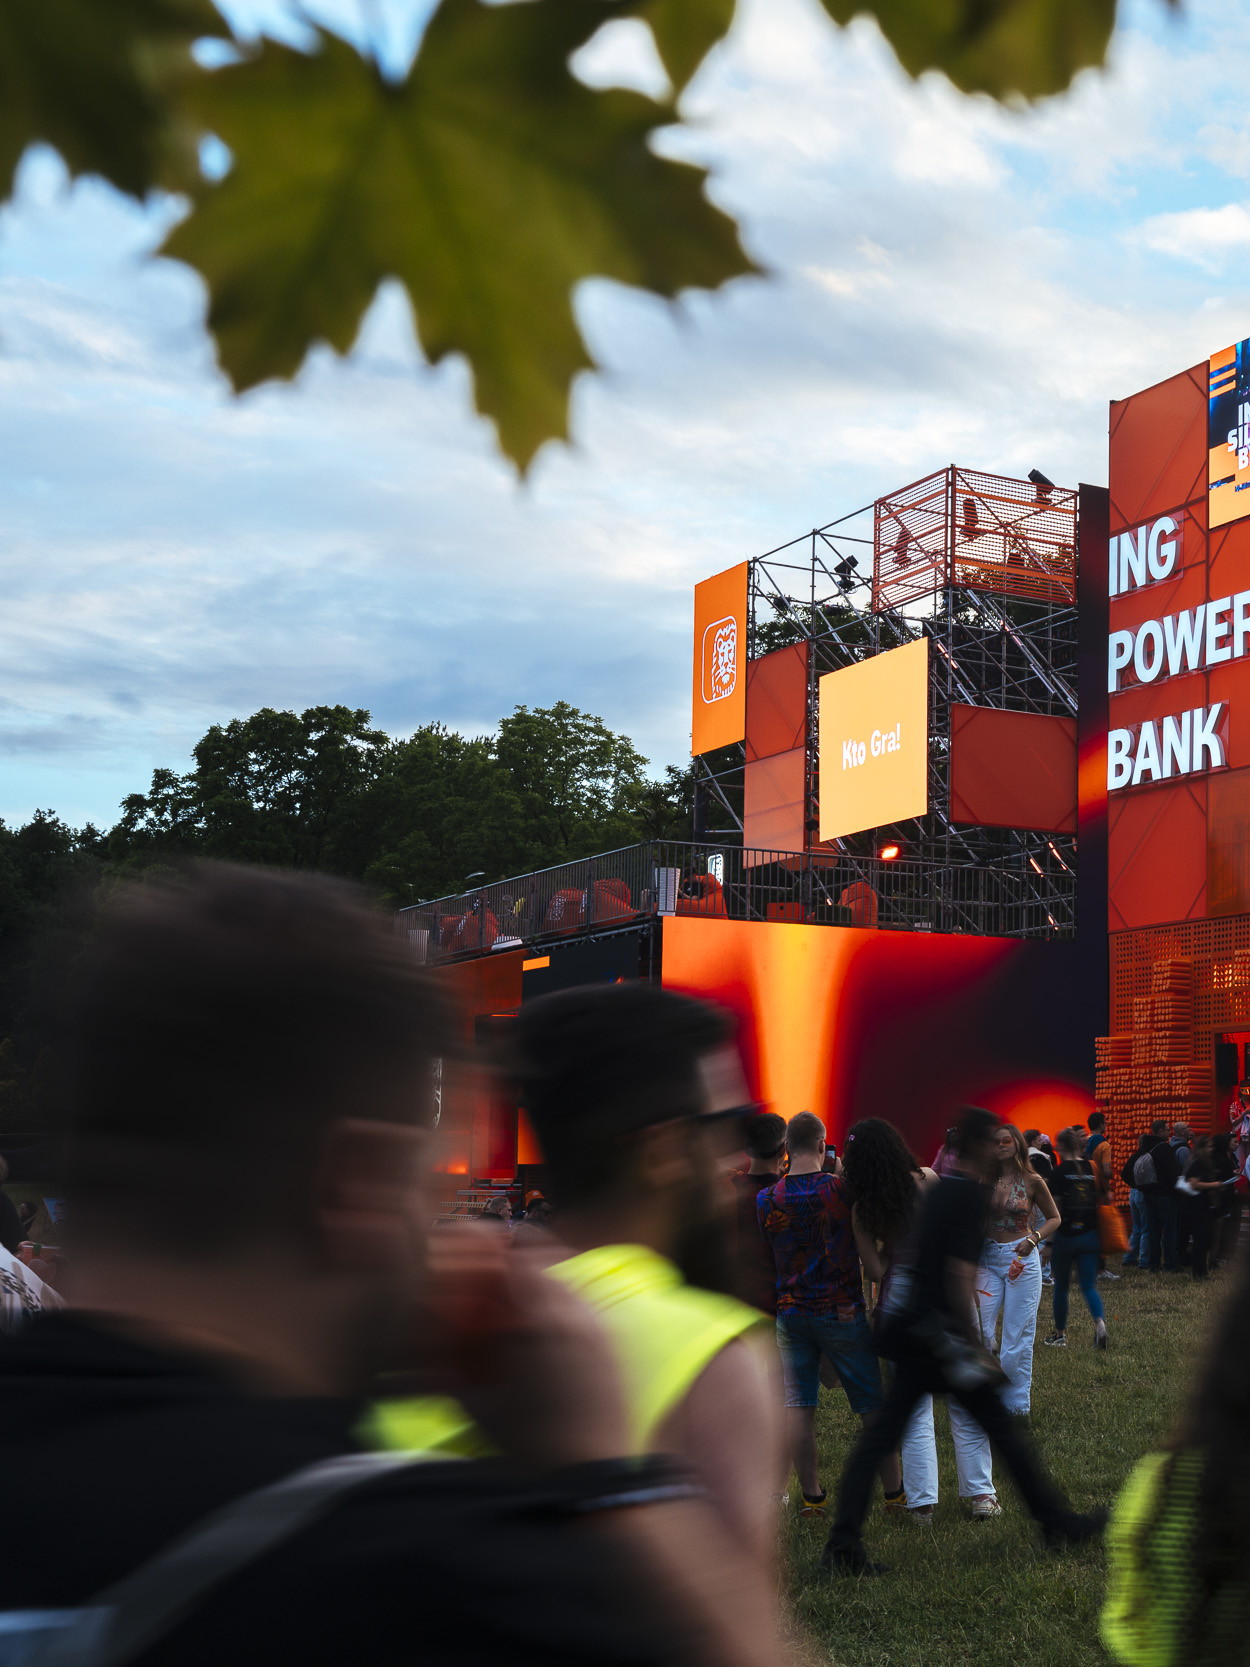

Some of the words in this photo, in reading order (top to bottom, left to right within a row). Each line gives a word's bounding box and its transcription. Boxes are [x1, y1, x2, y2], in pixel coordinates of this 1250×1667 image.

[1108, 515, 1181, 598] ING
[842, 737, 866, 770] Kto
[870, 722, 901, 758] Gra!
[1107, 702, 1226, 791] BANK
